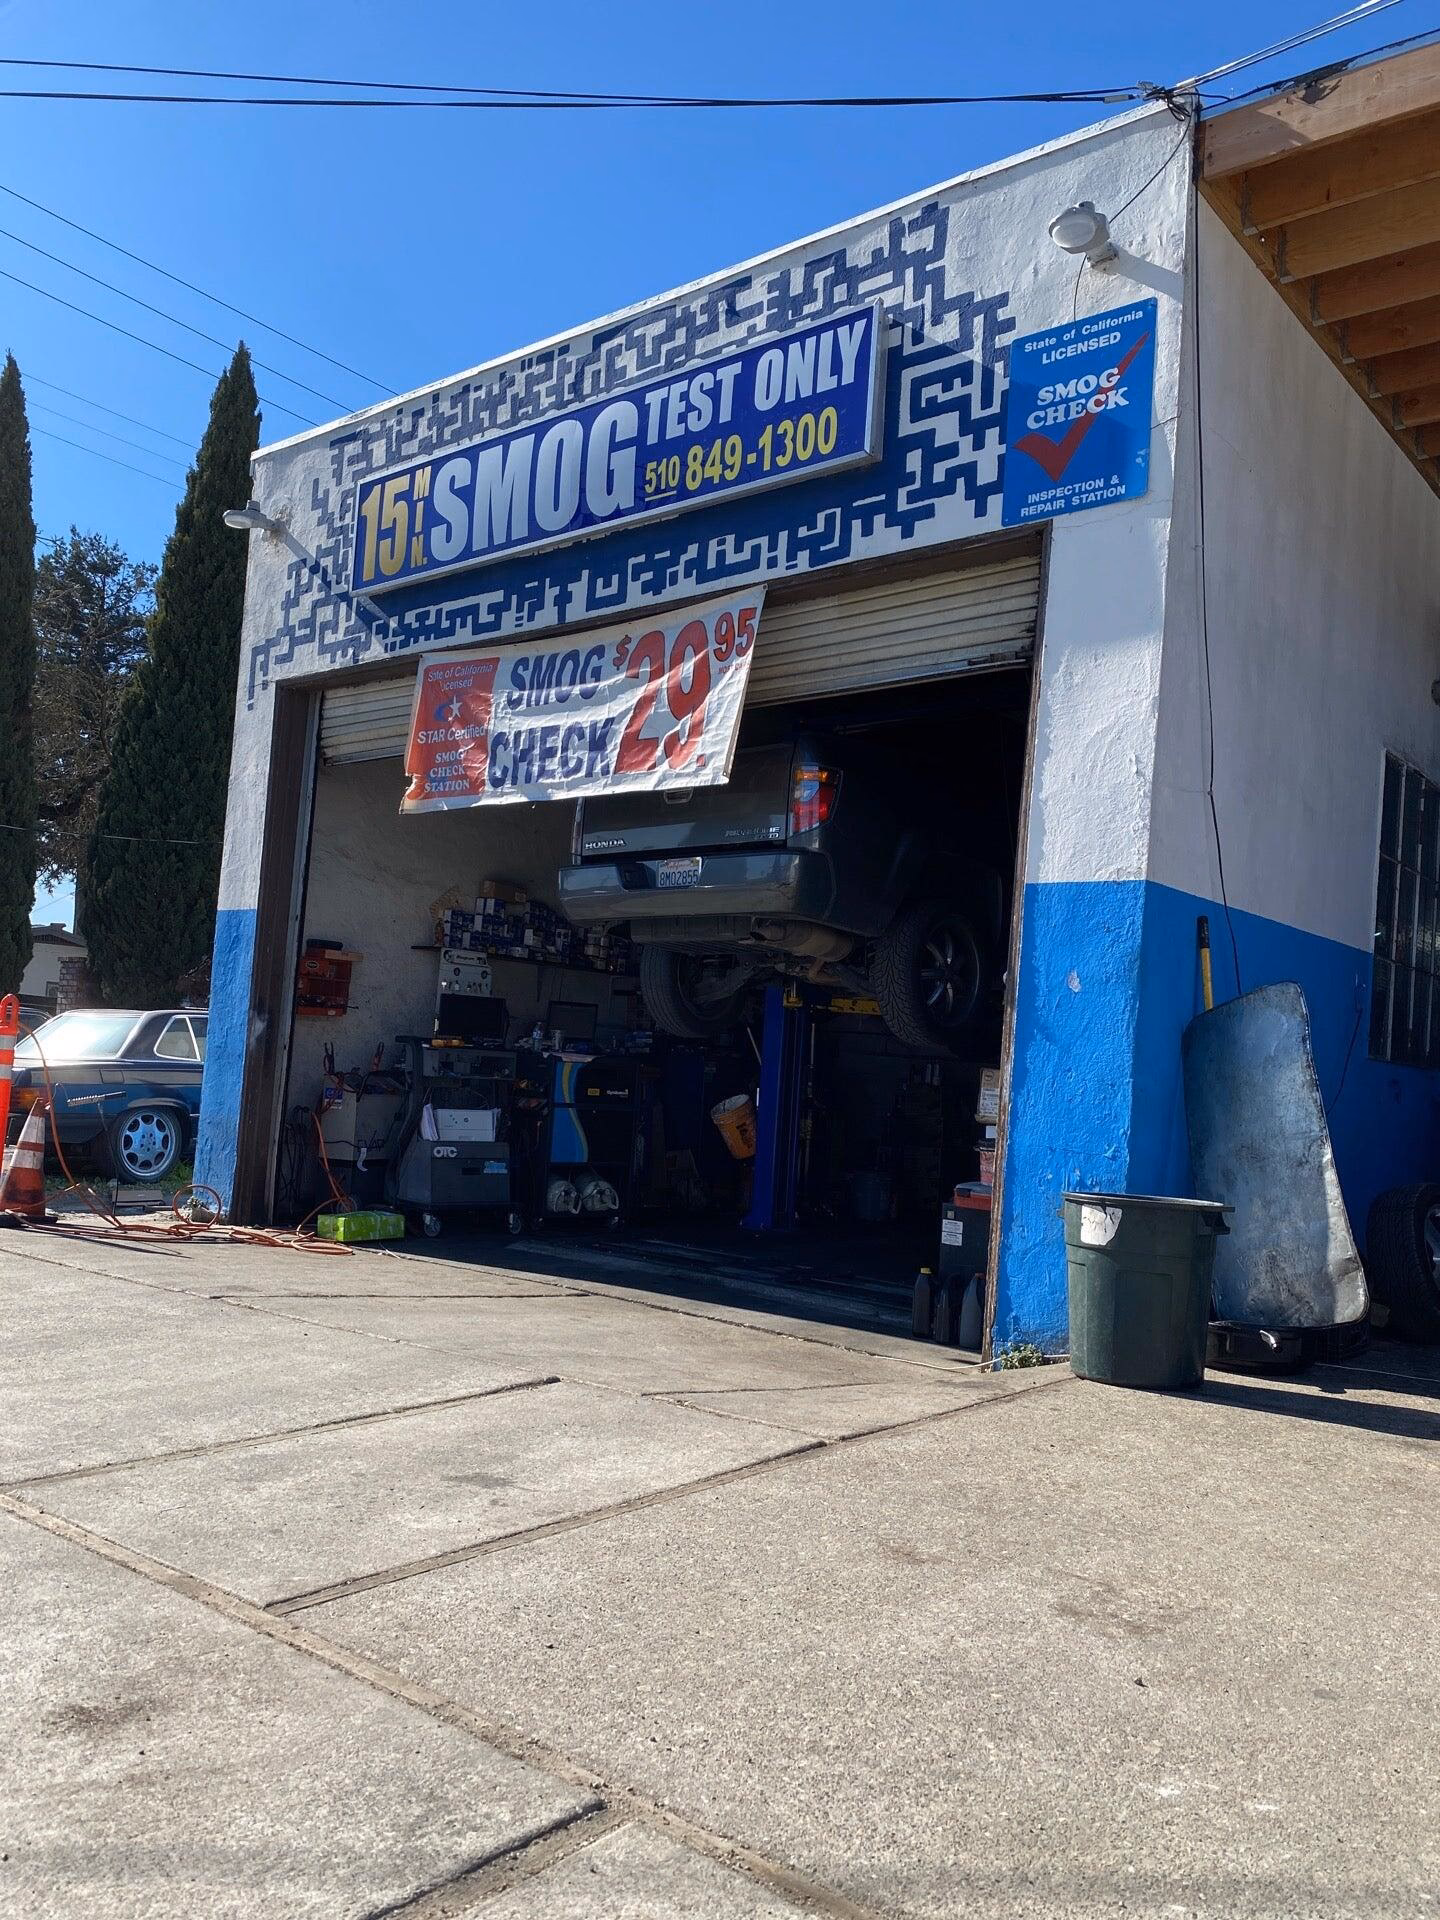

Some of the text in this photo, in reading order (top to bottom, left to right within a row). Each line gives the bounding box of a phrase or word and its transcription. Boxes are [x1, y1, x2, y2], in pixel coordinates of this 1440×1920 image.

[1024, 310, 1144, 353] State of California
[1042, 331, 1121, 365] LICENSED
[645, 318, 867, 445] TEST ONLY
[1036, 367, 1121, 406] SMOG
[1026, 386, 1130, 430] CHECK
[644, 405, 839, 494] 510 849-1300
[361, 474, 408, 582] 15
[430, 400, 638, 562] SMOG
[1021, 484, 1126, 518] REPAIR STATION
[1028, 474, 1120, 504] INSPECTION &
[427, 664, 493, 682] Sate of California
[507, 643, 606, 711] SMOG
[417, 724, 488, 744] STAR Certified
[435, 749, 465, 764] SMOG
[487, 716, 615, 788] CHECK
[424, 779, 470, 793] STATION
[430, 765, 465, 778] CHECK
[585, 838, 626, 850] HONDA
[433, 1146, 458, 1158] OTC
